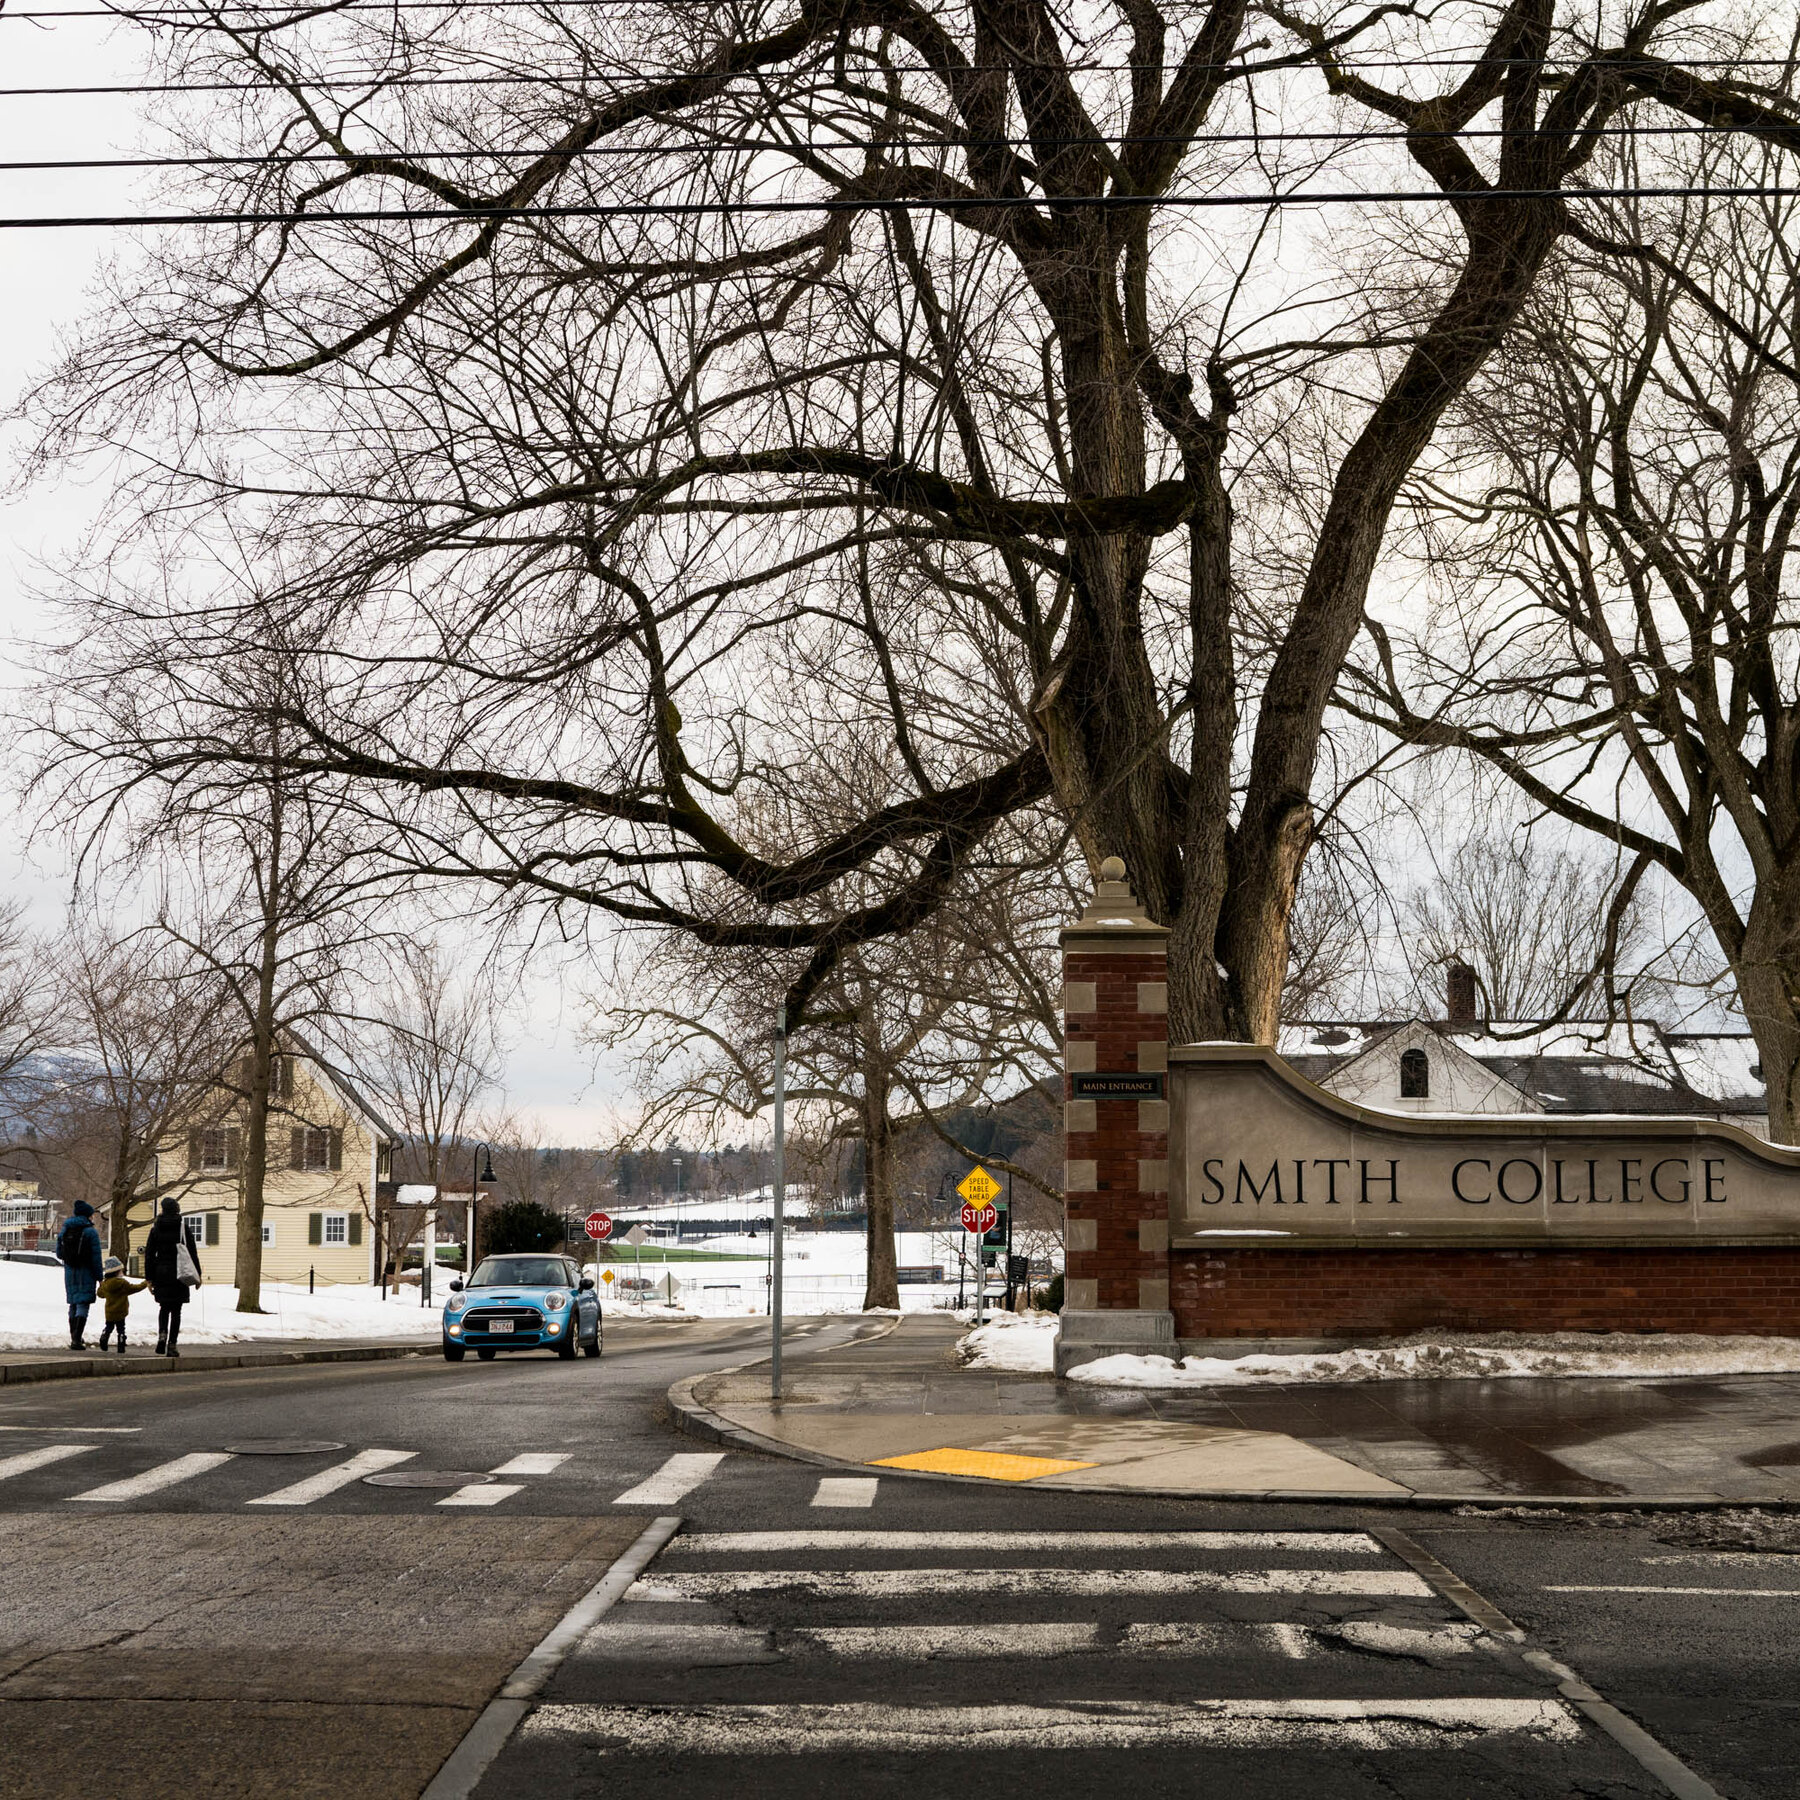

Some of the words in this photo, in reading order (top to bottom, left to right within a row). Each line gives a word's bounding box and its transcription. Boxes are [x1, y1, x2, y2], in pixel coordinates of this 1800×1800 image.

[1201, 1158, 1402, 1206] SMITH
[1451, 1158, 1728, 1204] COLLEGE
[587, 1220, 610, 1231] STOP
